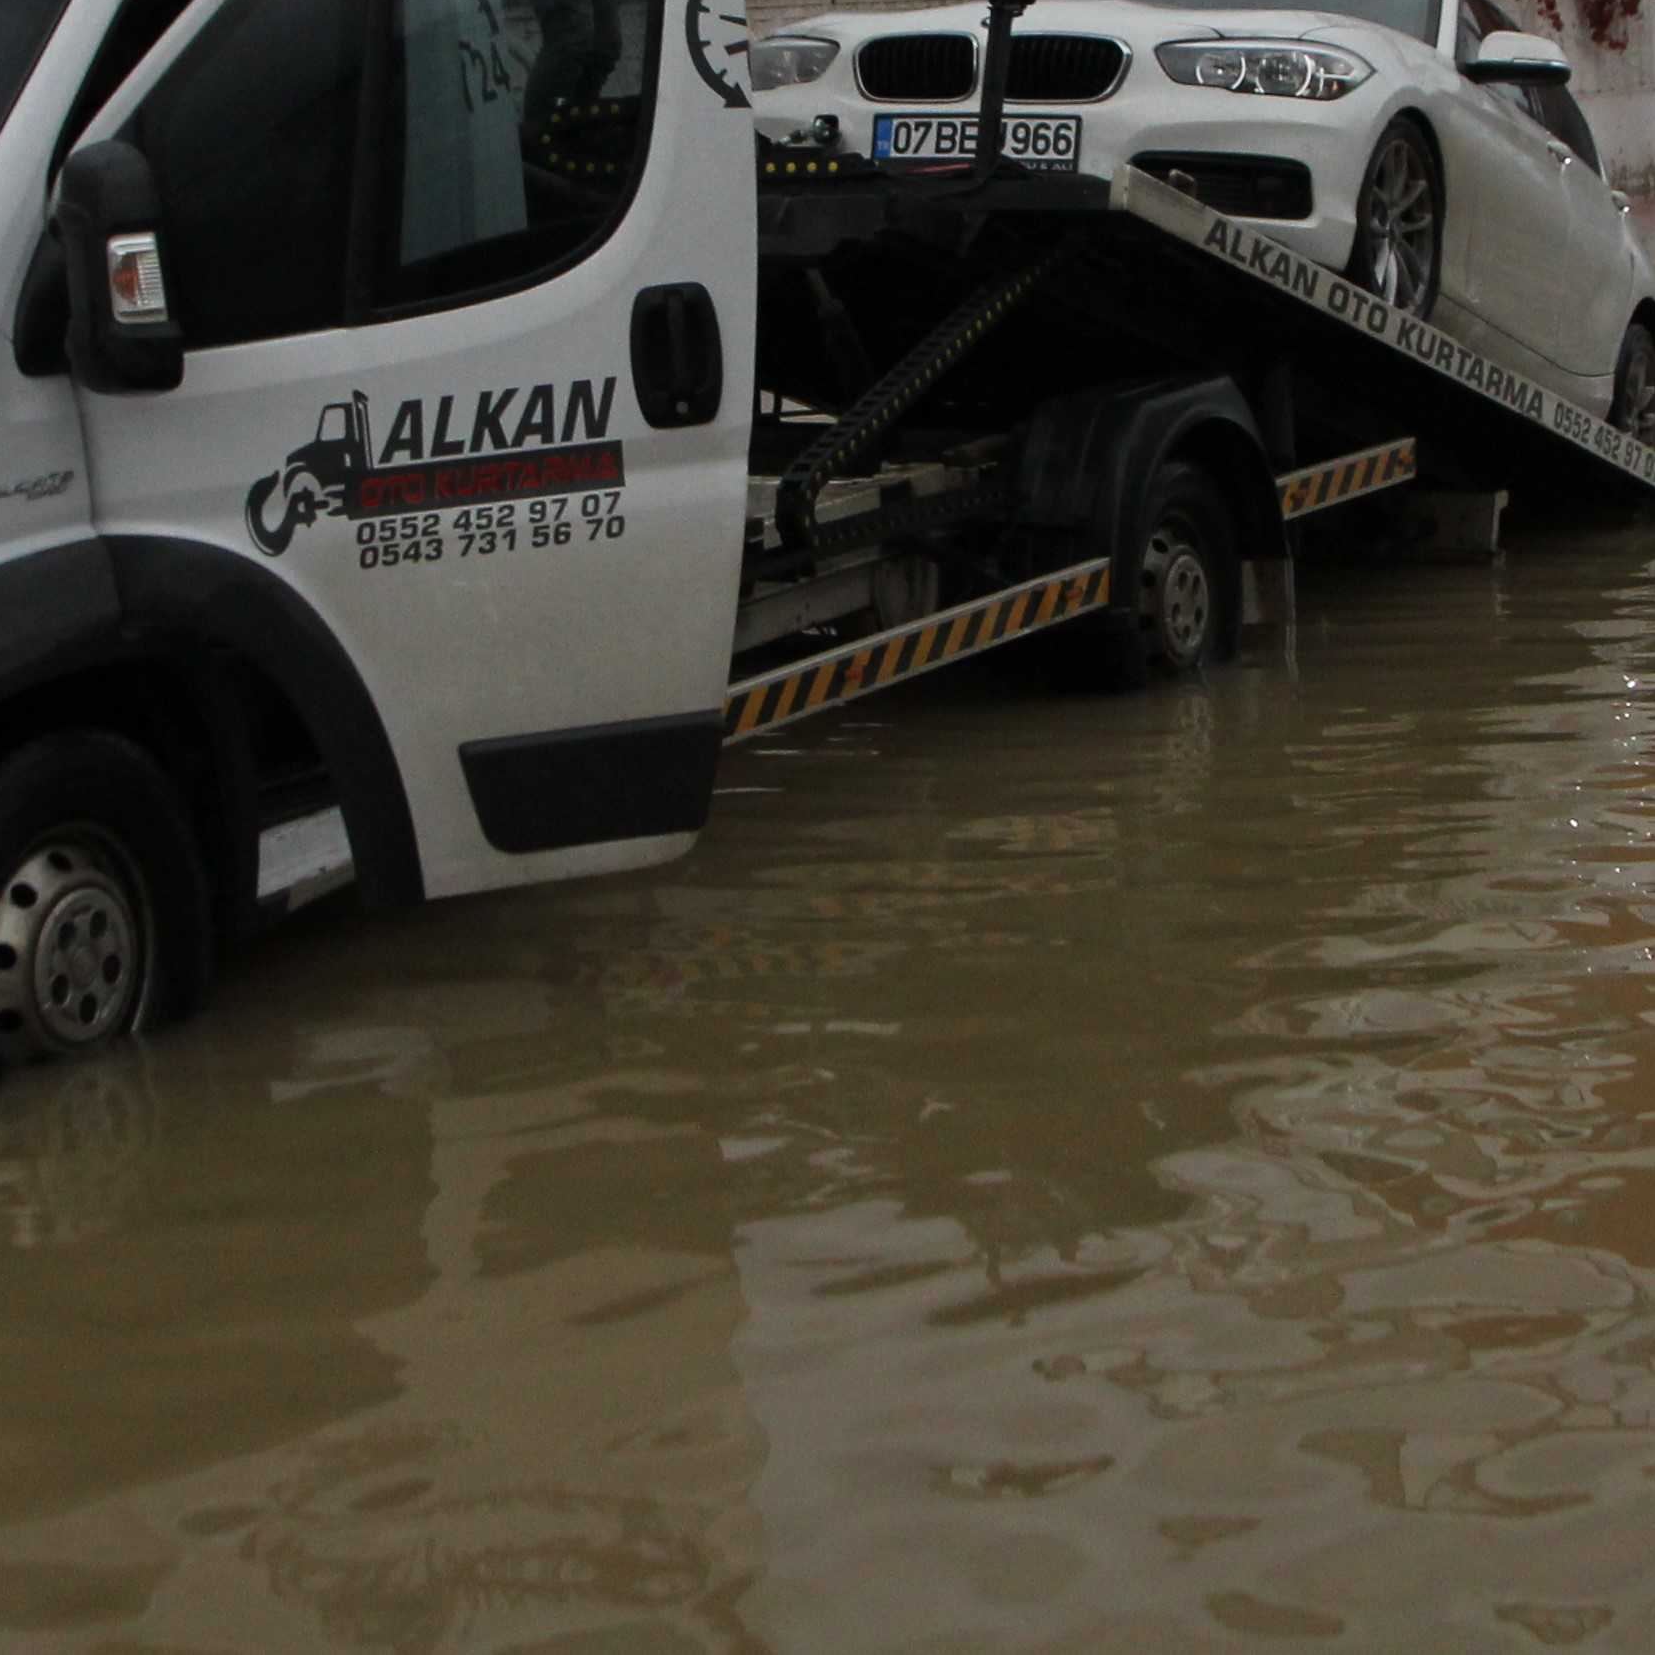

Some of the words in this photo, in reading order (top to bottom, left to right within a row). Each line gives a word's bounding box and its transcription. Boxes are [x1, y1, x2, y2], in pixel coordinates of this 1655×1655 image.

[893, 121, 933, 154] 07
[935, 121, 1008, 155] BE
[1011, 122, 1073, 156] 966
[1204, 218, 1320, 300] ALKAN
[1327, 282, 1390, 334] OTO
[1396, 317, 1546, 420] KURTARMA
[1553, 401, 1593, 443] 0552
[1595, 425, 1623, 461] 452
[1624, 441, 1644, 472] 97
[378, 376, 618, 464] ALKAN
[361, 472, 426, 507] OTO
[434, 452, 619, 497] KURTARMA
[356, 513, 441, 545] 0552
[452, 504, 516, 531] 452
[529, 497, 569, 524] 97
[581, 491, 622, 518] 07
[359, 538, 444, 569] 0543
[458, 529, 517, 558] 731
[532, 522, 572, 548] 56
[586, 515, 625, 541] 70
